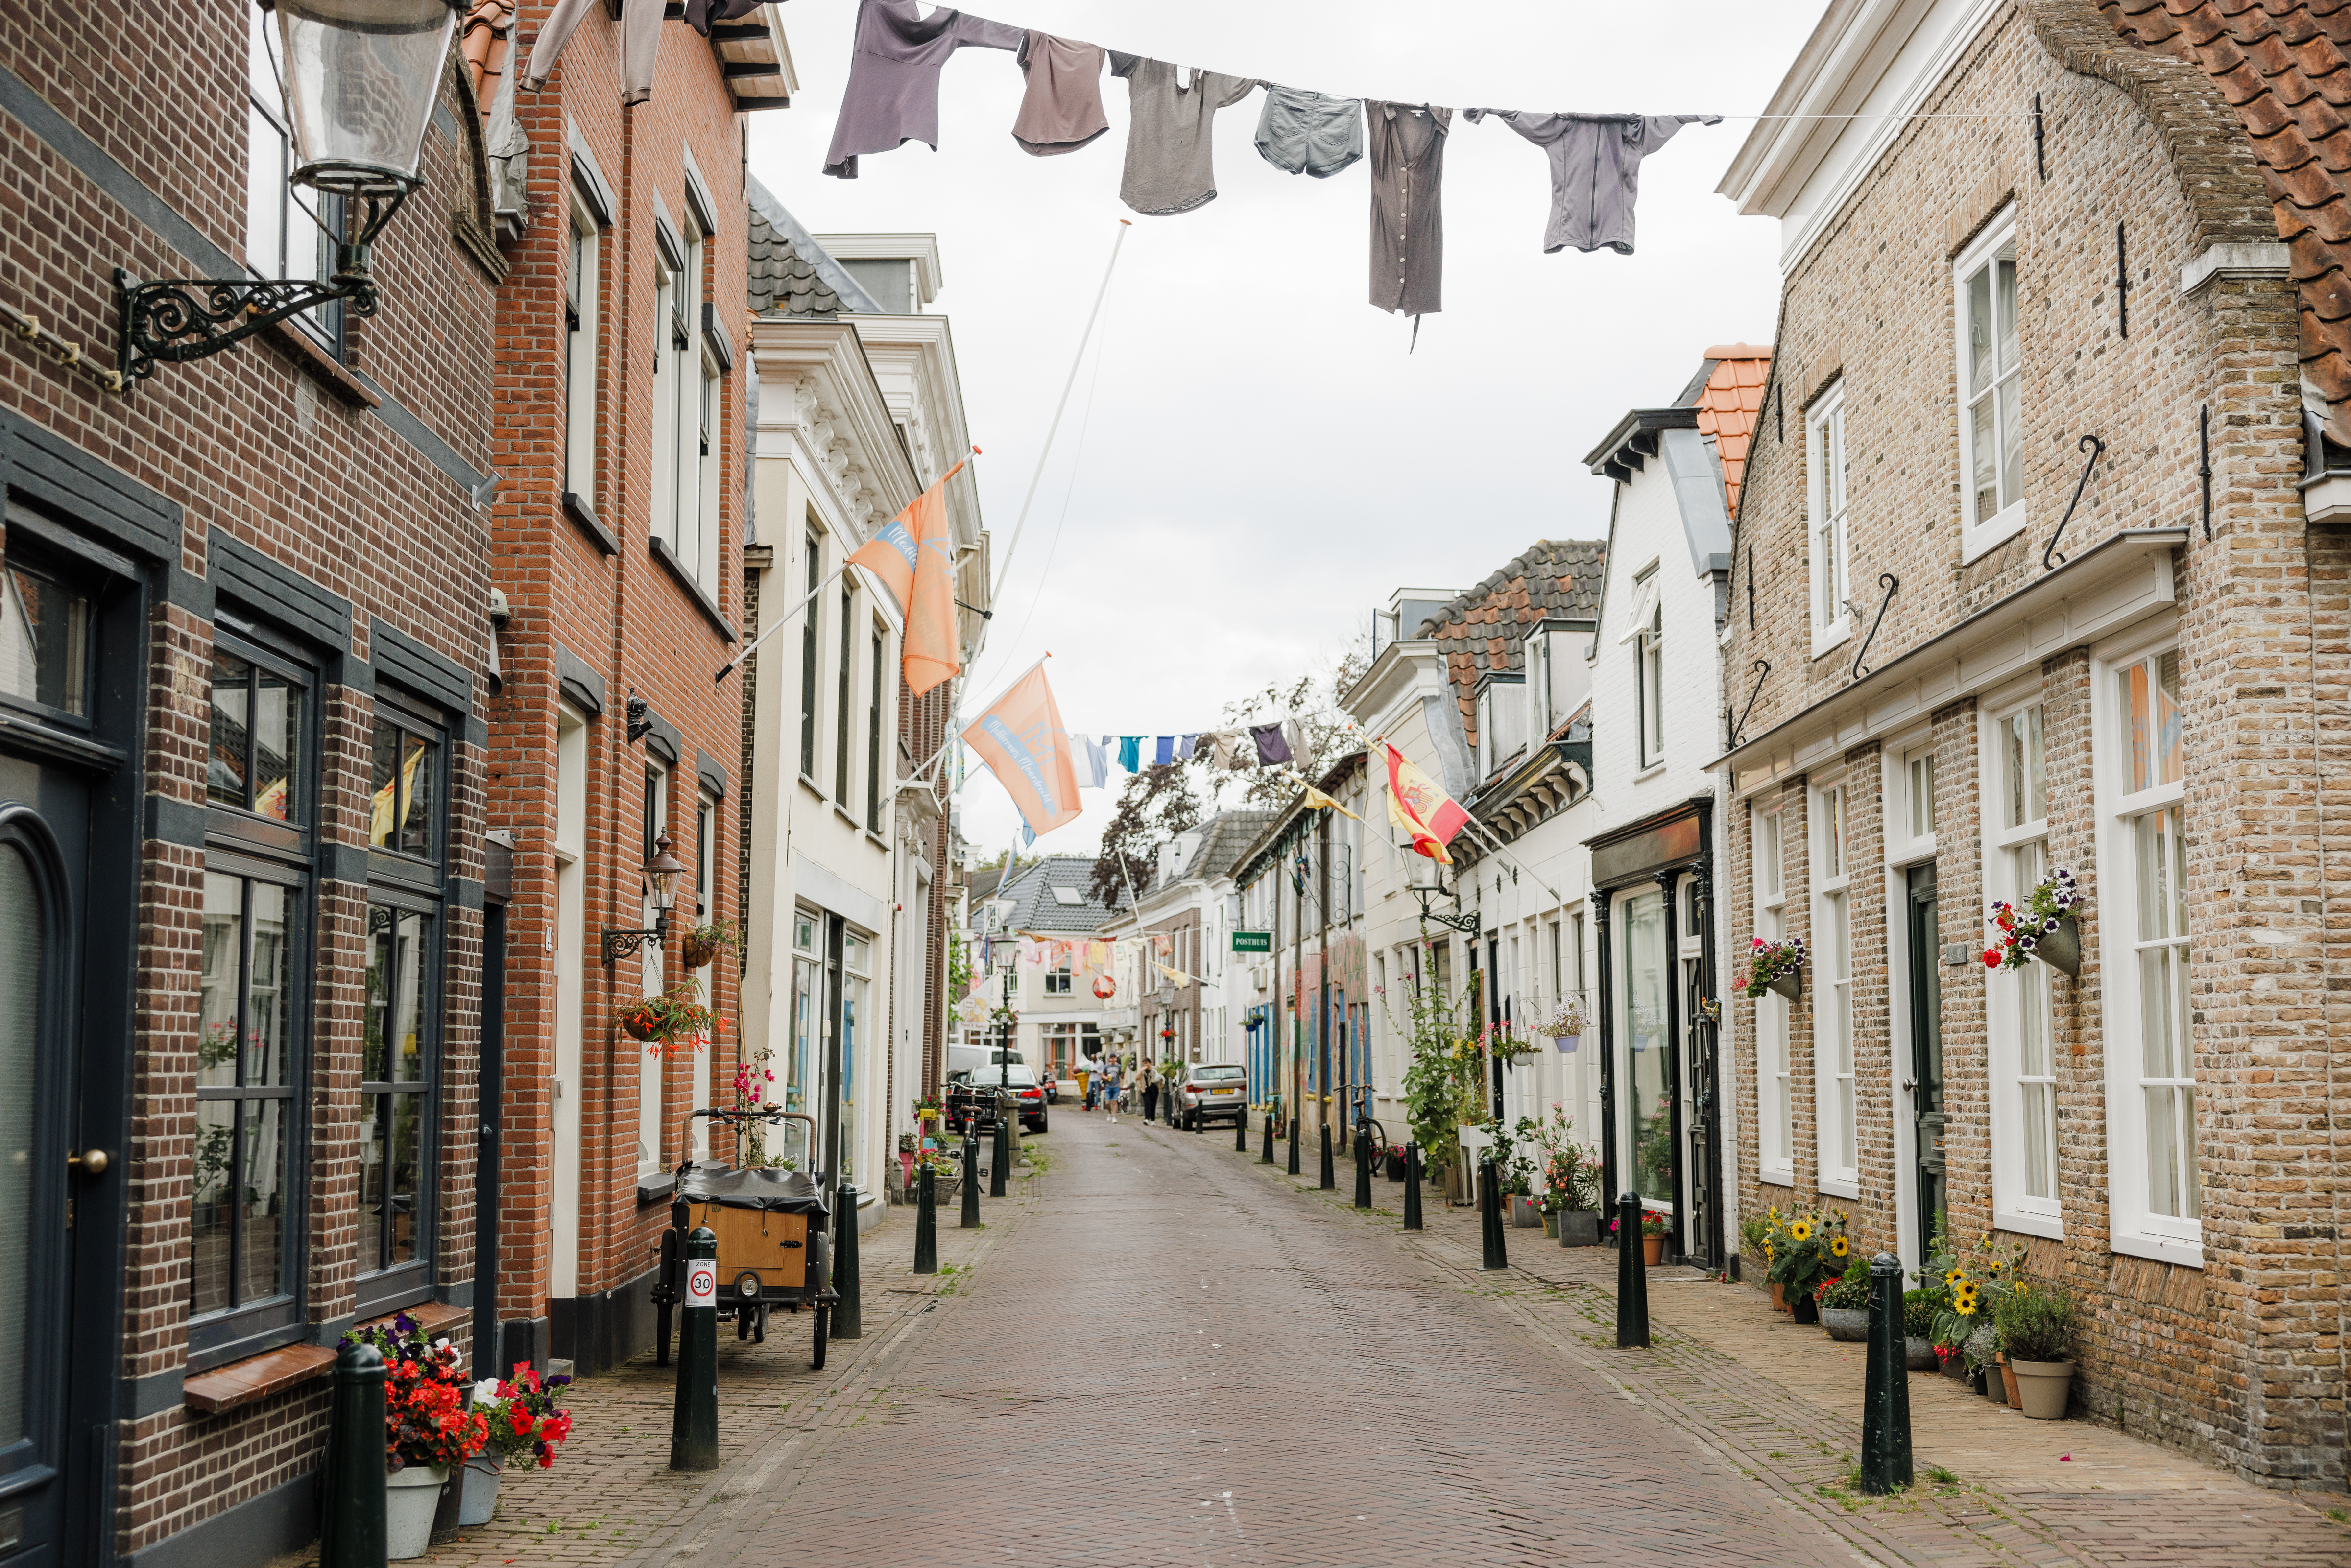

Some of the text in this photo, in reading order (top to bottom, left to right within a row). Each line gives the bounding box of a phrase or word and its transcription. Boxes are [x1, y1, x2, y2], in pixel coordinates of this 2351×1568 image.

[887, 525, 918, 568] Medite
[988, 719, 1052, 804] Mediterraans Moordrecht
[695, 1278, 710, 1289] 30
